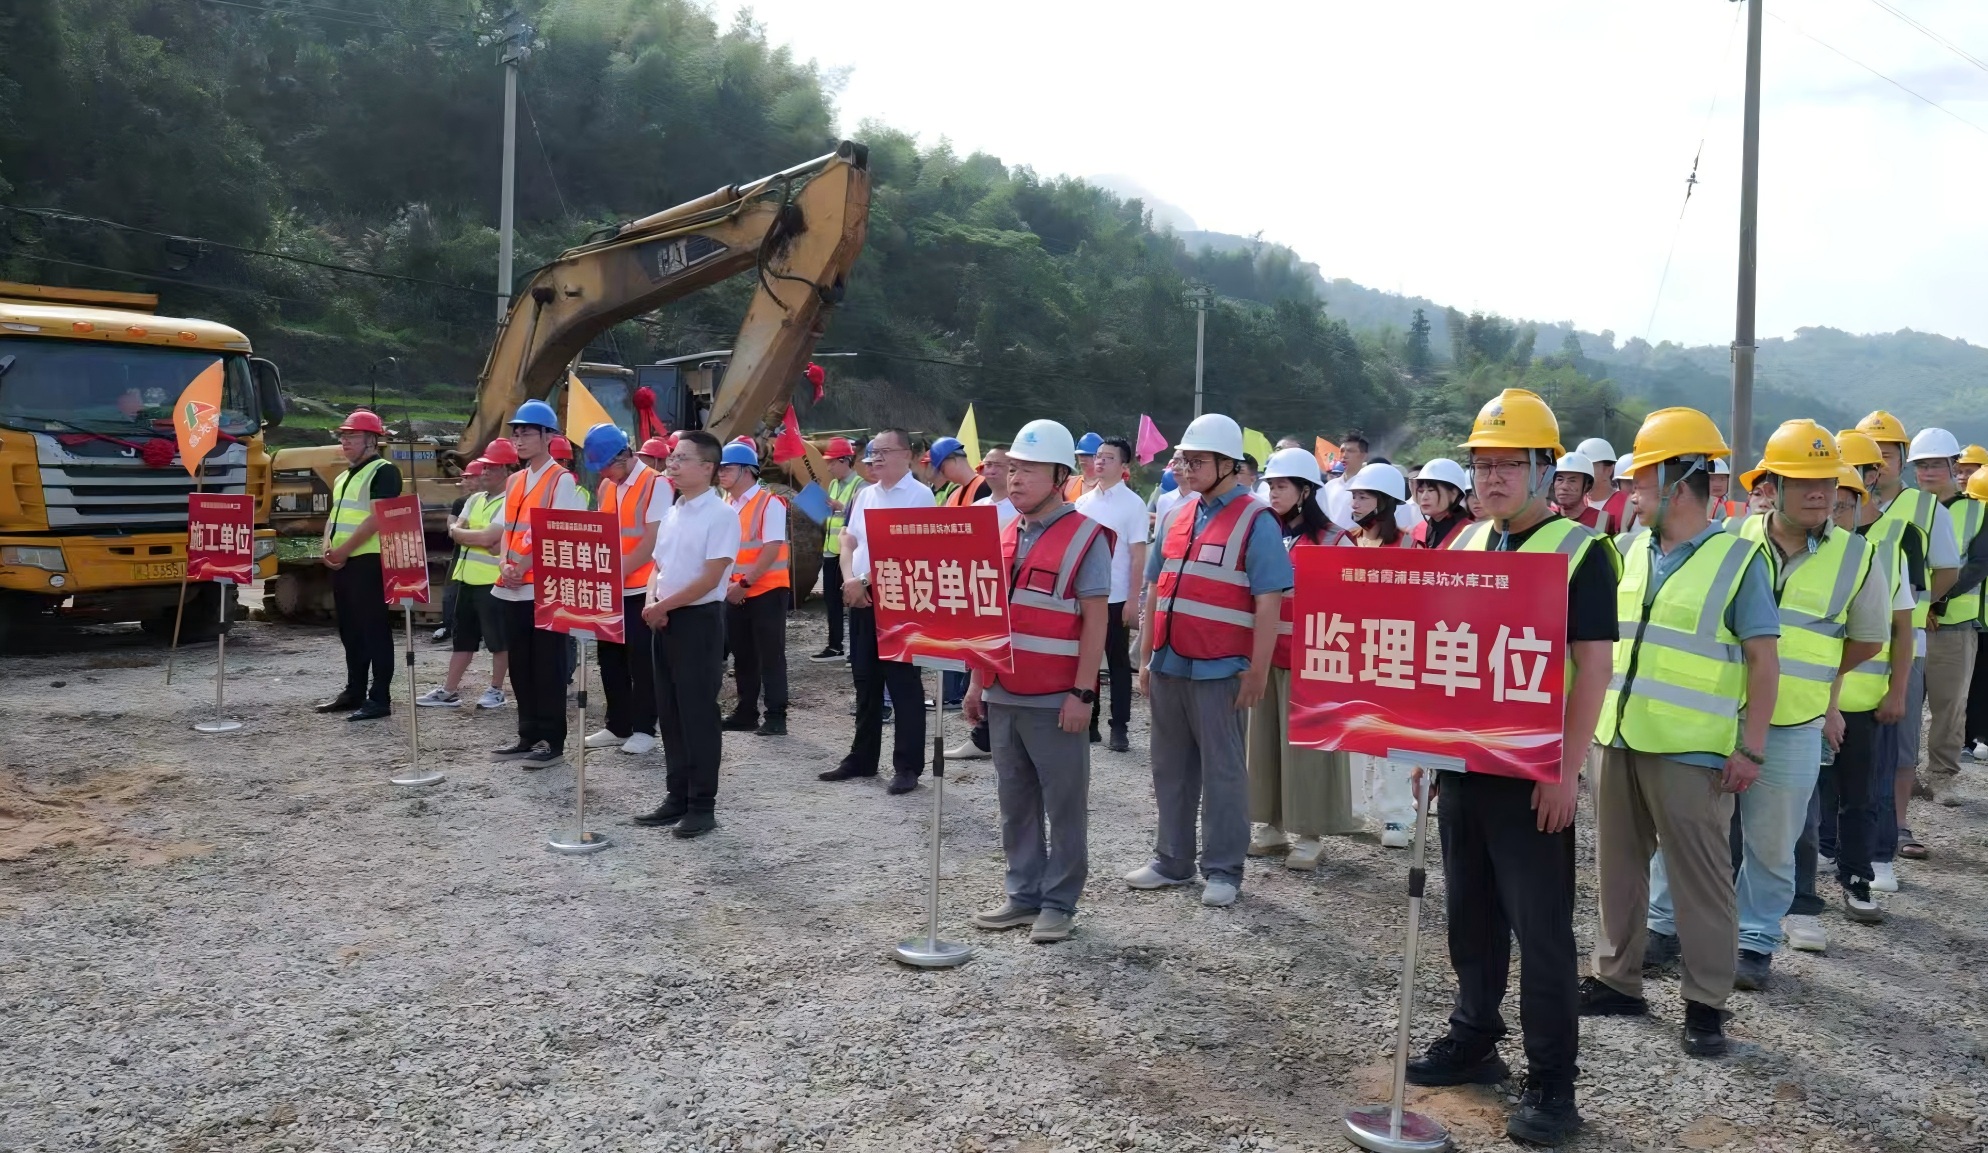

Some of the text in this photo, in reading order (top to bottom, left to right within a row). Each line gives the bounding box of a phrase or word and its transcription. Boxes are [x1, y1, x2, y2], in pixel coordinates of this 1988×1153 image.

[189, 521, 251, 555] 施工单位
[541, 539, 612, 574] 县直单位
[542, 575, 613, 612] 乡镇街道
[874, 557, 1003, 617] 建设单位
[1341, 567, 1510, 590] 福建省霞浦县吴坑水库工程
[1300, 611, 1553, 704] 监理单位
